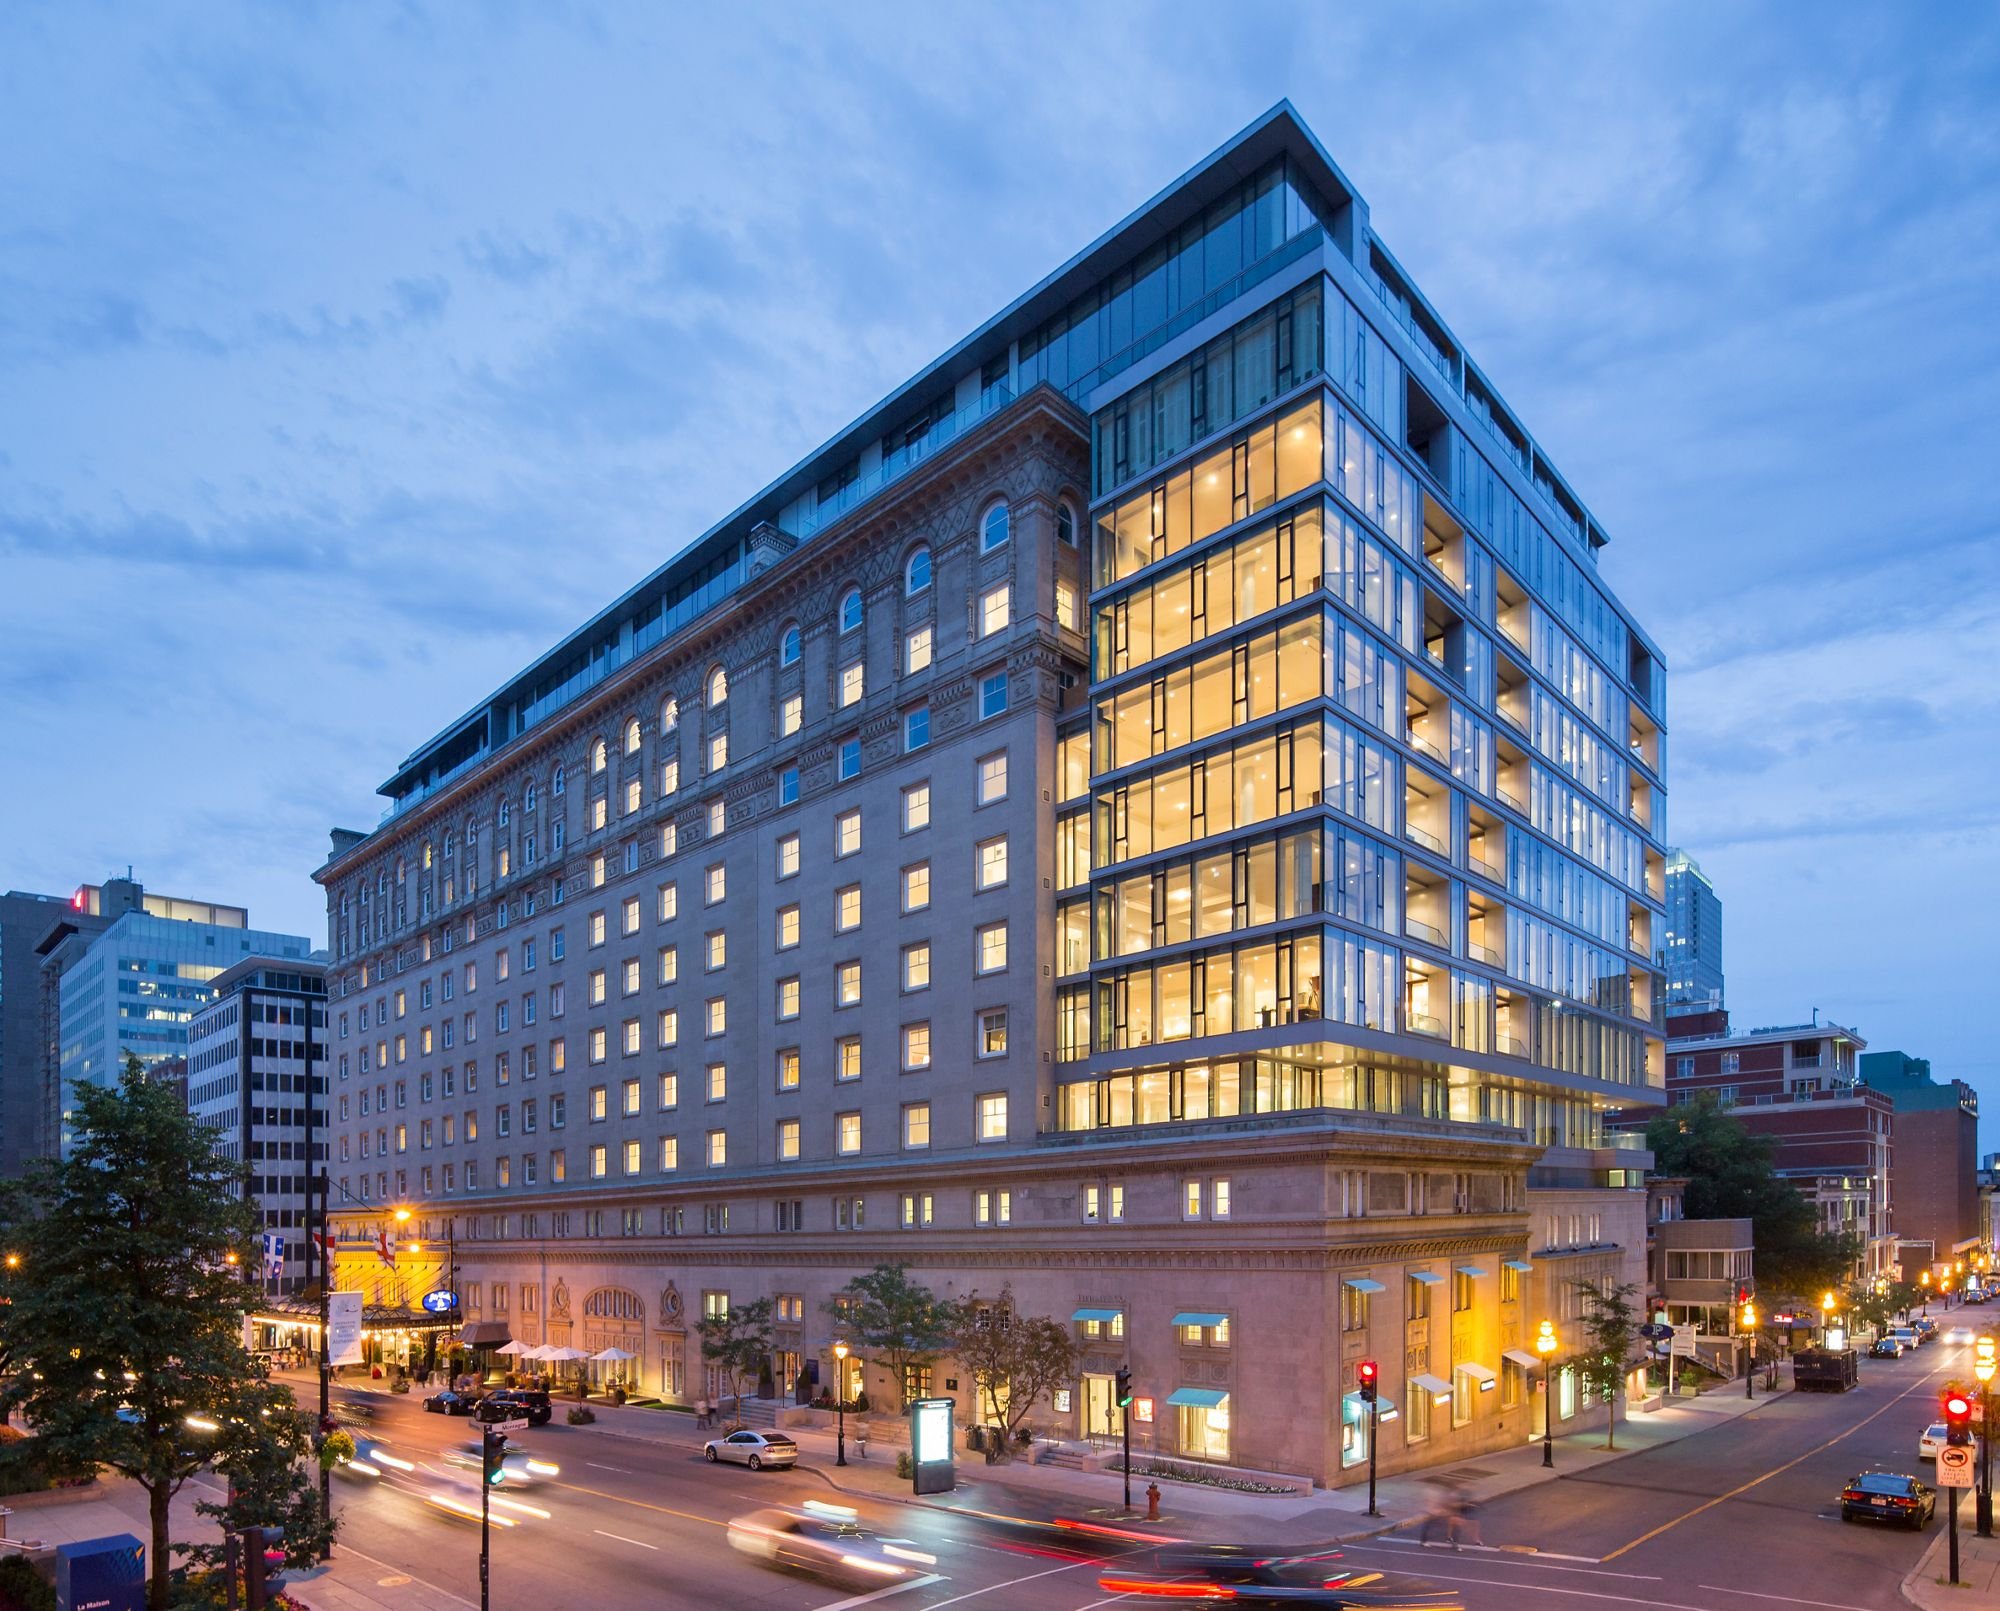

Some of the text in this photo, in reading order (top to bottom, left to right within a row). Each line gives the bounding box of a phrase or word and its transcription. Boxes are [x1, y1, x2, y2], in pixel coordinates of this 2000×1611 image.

[1652, 1325, 1664, 1336] P
[501, 1422, 527, 1431] Montagne
[86, 1599, 110, 1610] Maison
